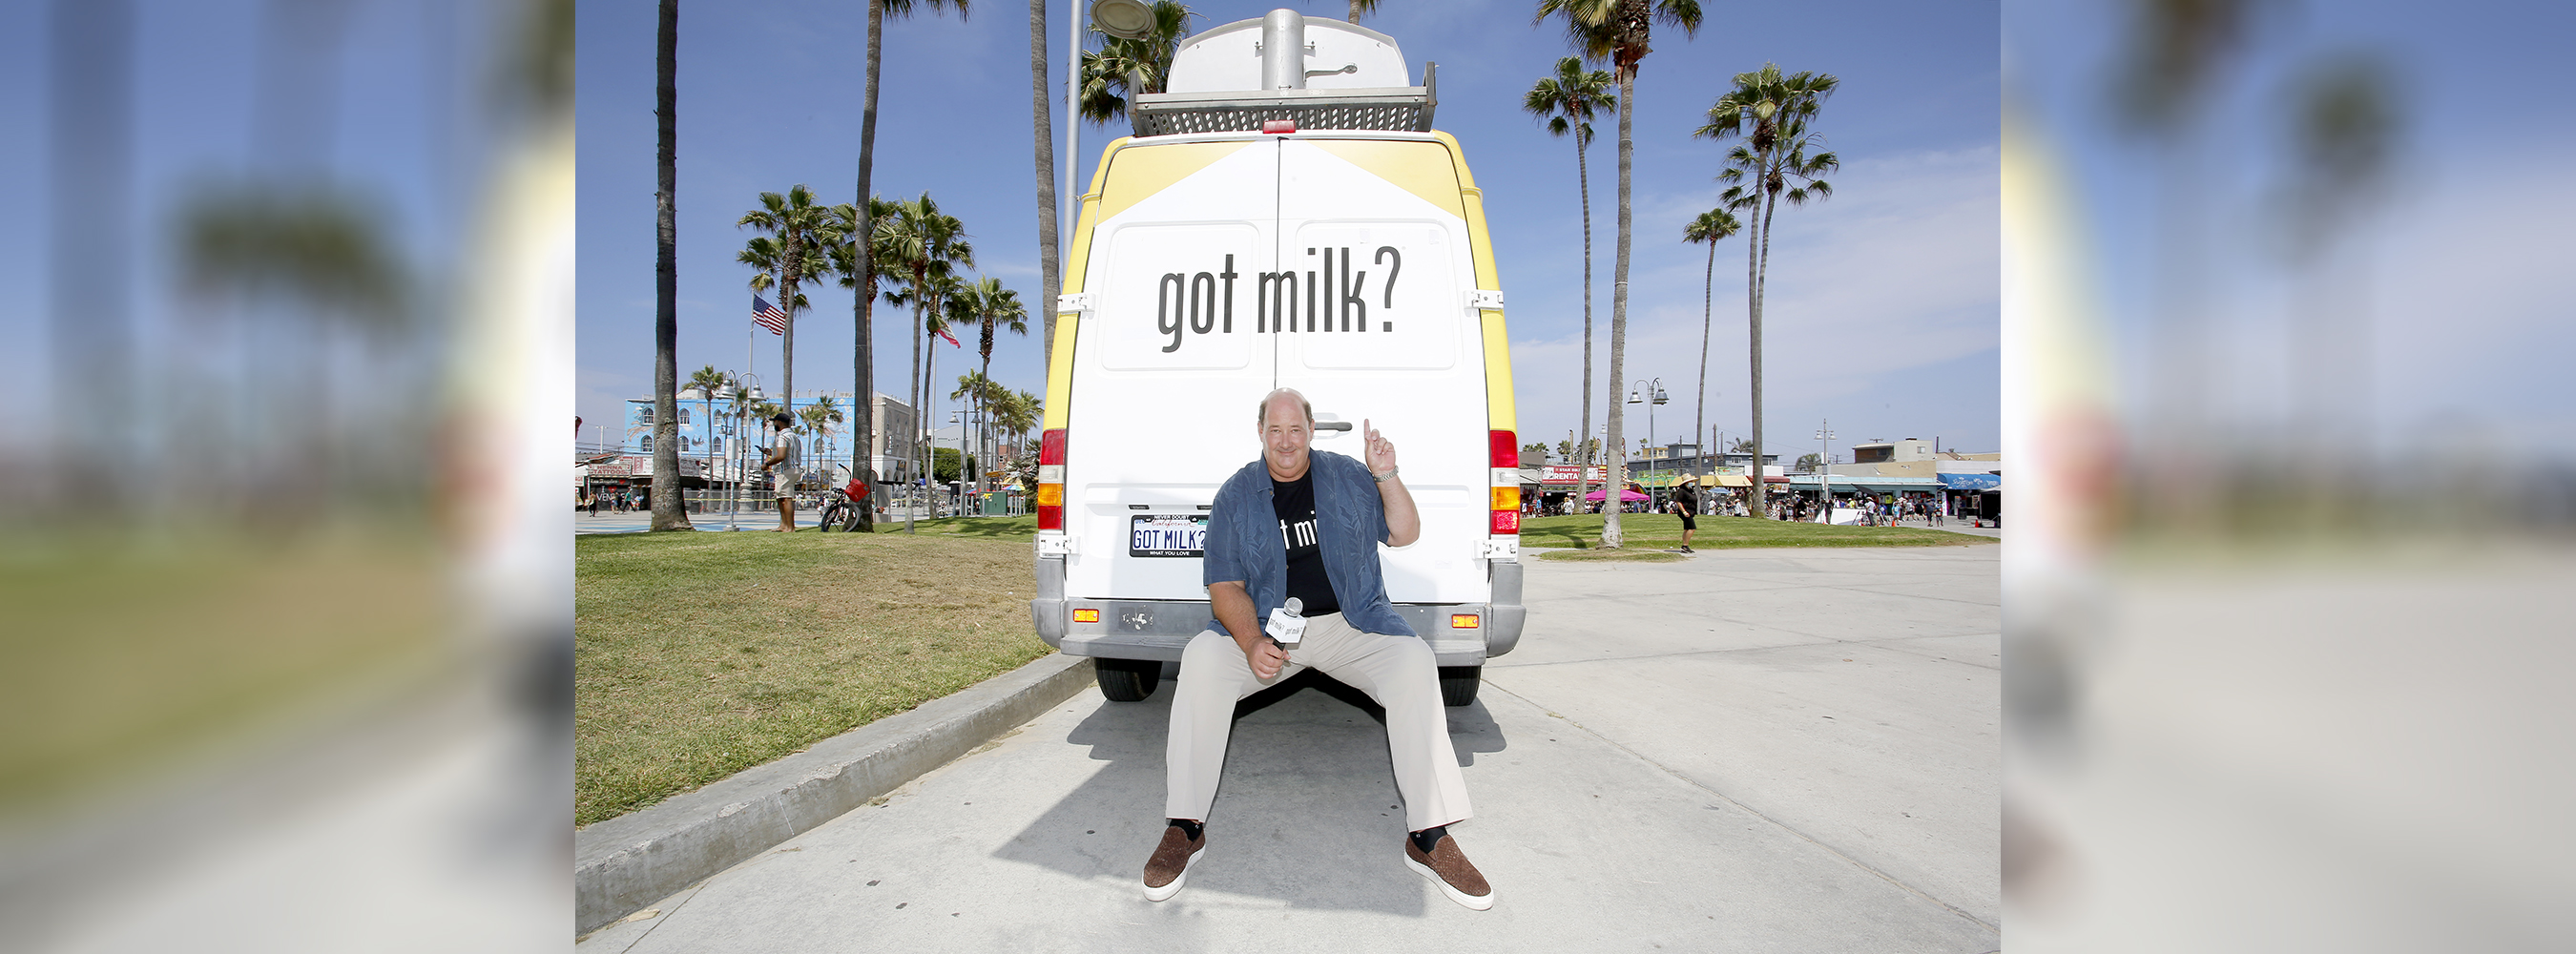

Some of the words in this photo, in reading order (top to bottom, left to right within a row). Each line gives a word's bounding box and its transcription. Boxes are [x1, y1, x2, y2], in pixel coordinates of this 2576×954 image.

[1157, 254, 1238, 353] got
[1257, 245, 1402, 334] milk?
[596, 493, 626, 502] VENE
[1133, 529, 1160, 549] GOT
[1164, 529, 1206, 550] MILK?
